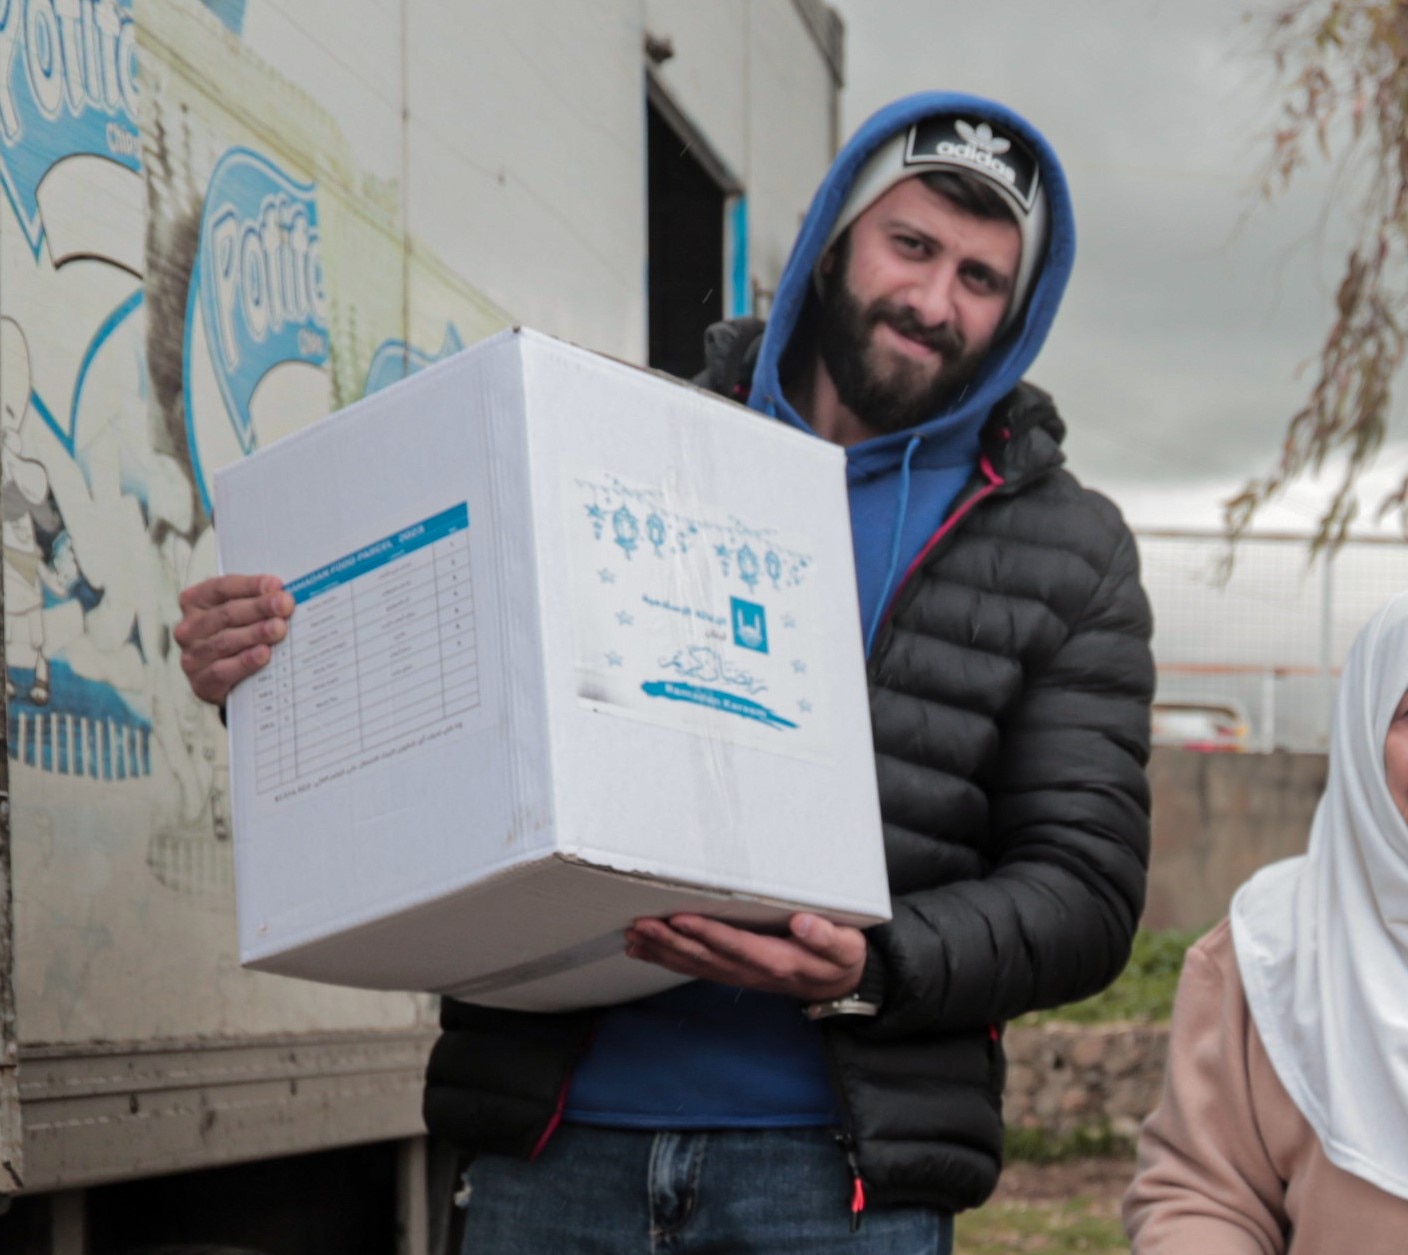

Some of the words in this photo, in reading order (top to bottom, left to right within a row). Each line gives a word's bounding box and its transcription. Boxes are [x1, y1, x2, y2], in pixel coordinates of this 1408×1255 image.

[936, 141, 1016, 184] adidas
[664, 682, 722, 708] Ramadan
[722, 699, 769, 719] Kareem
